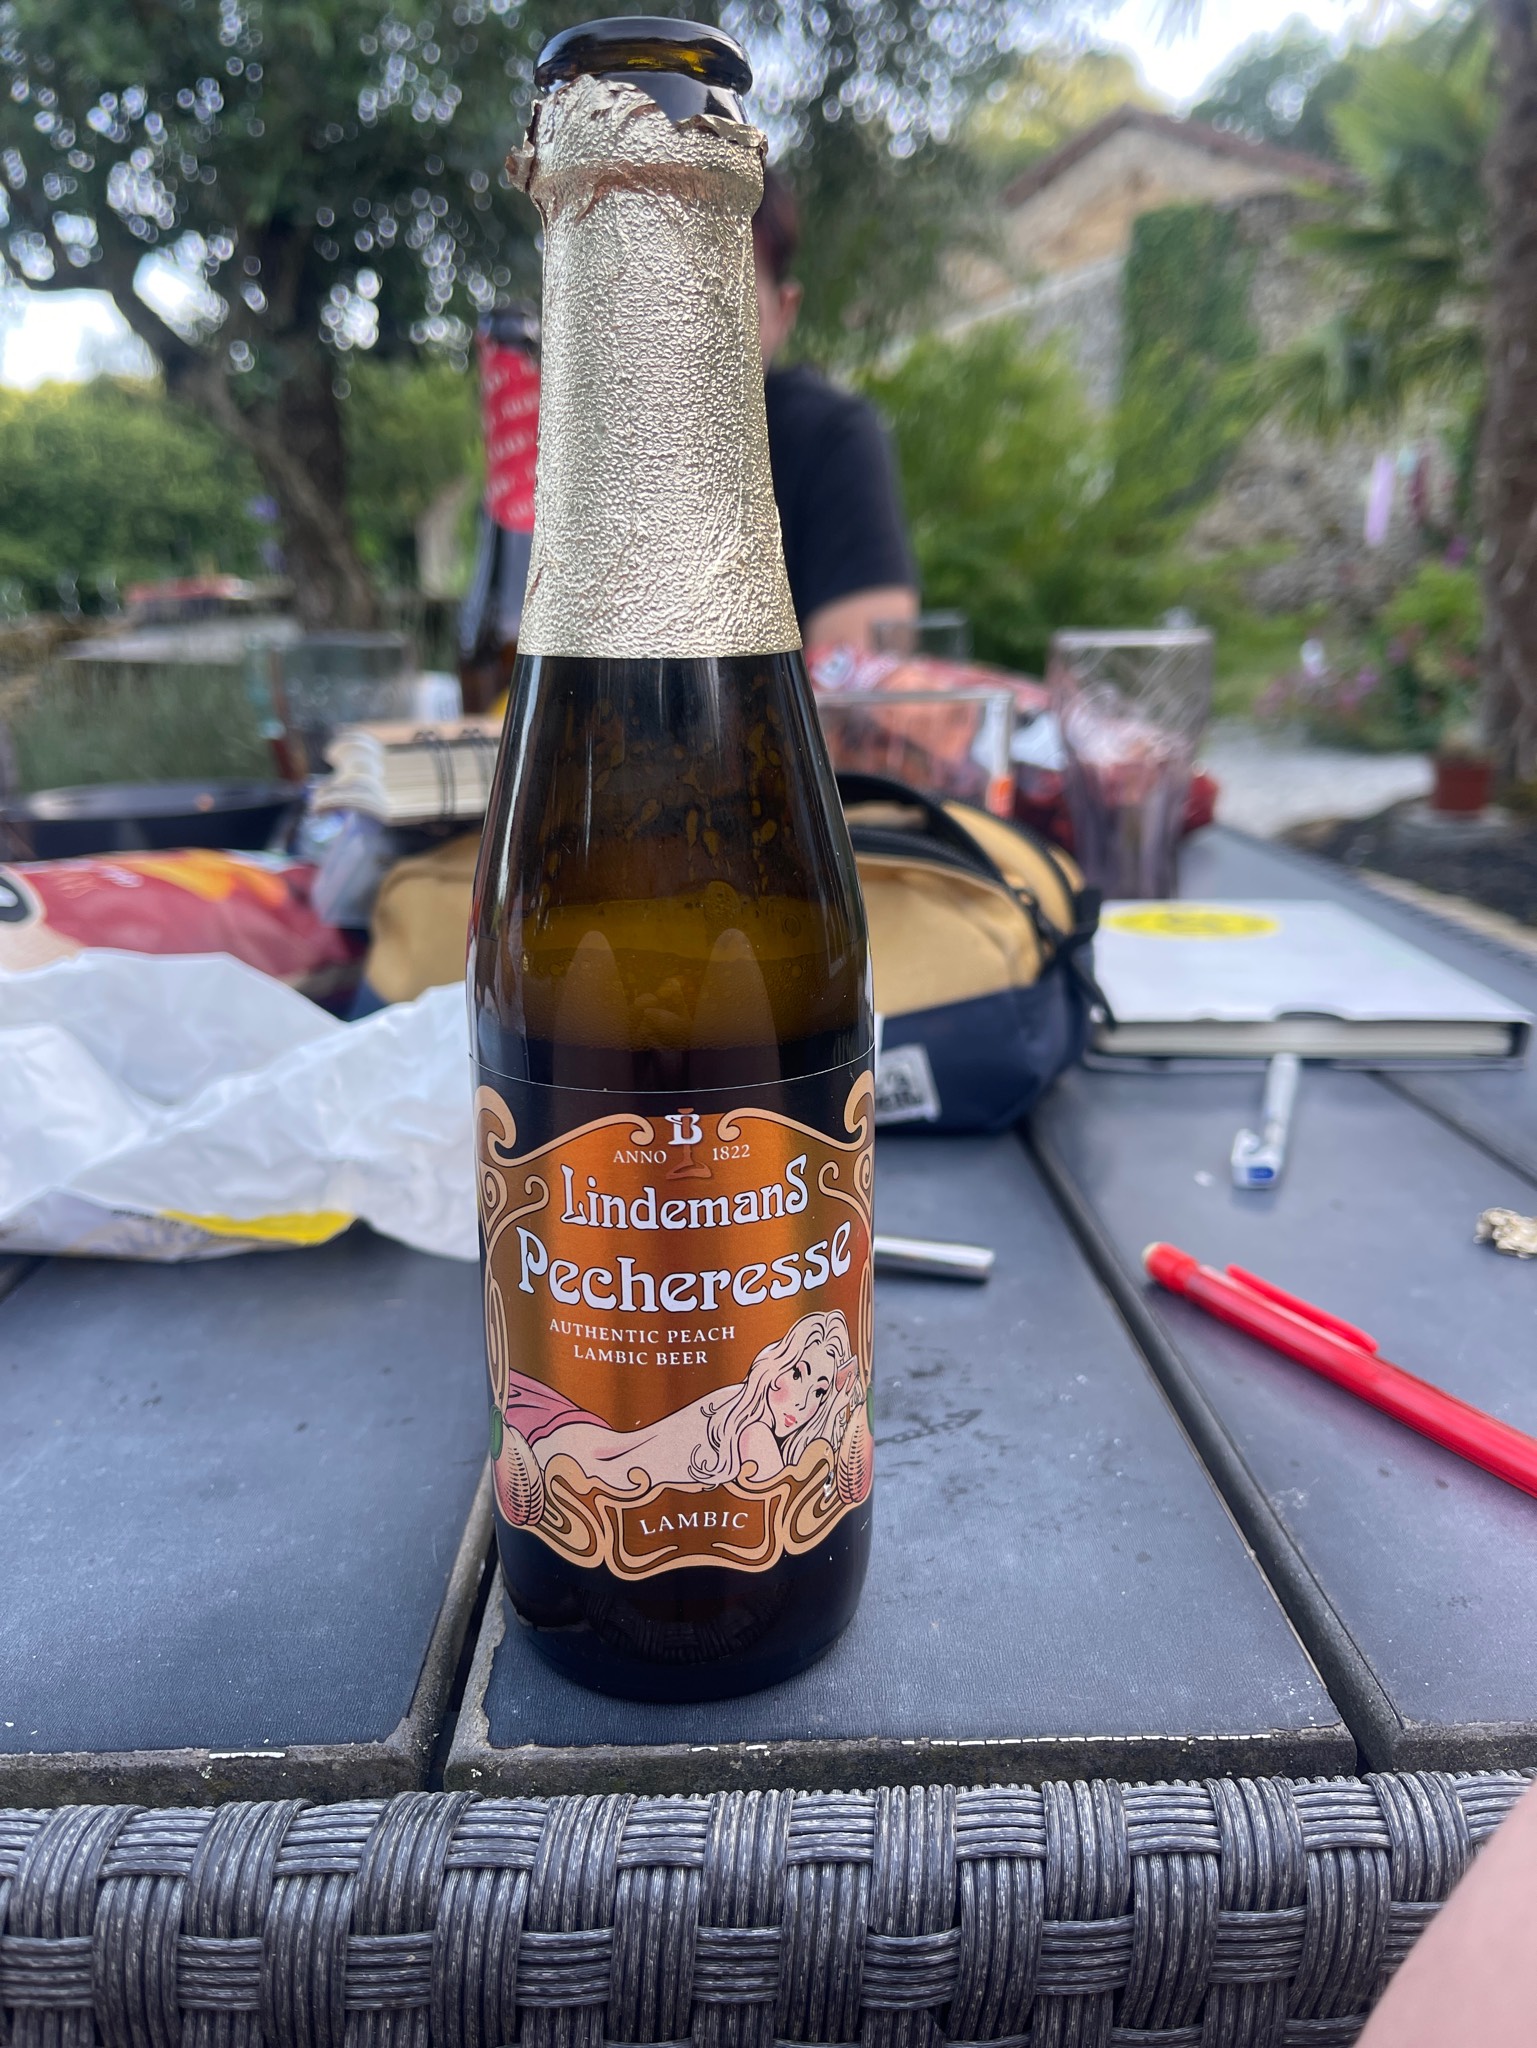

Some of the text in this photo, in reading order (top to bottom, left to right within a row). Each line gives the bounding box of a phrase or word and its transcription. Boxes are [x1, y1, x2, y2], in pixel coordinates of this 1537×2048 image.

[612, 1144, 750, 1164] ANNO 1822
[515, 1220, 852, 1313] Pecheresse
[548, 1318, 736, 1344] AUTHENTIC PEACH
[573, 1345, 708, 1366] LAMBIC BEER
[639, 1511, 749, 1536] LAMBIC
